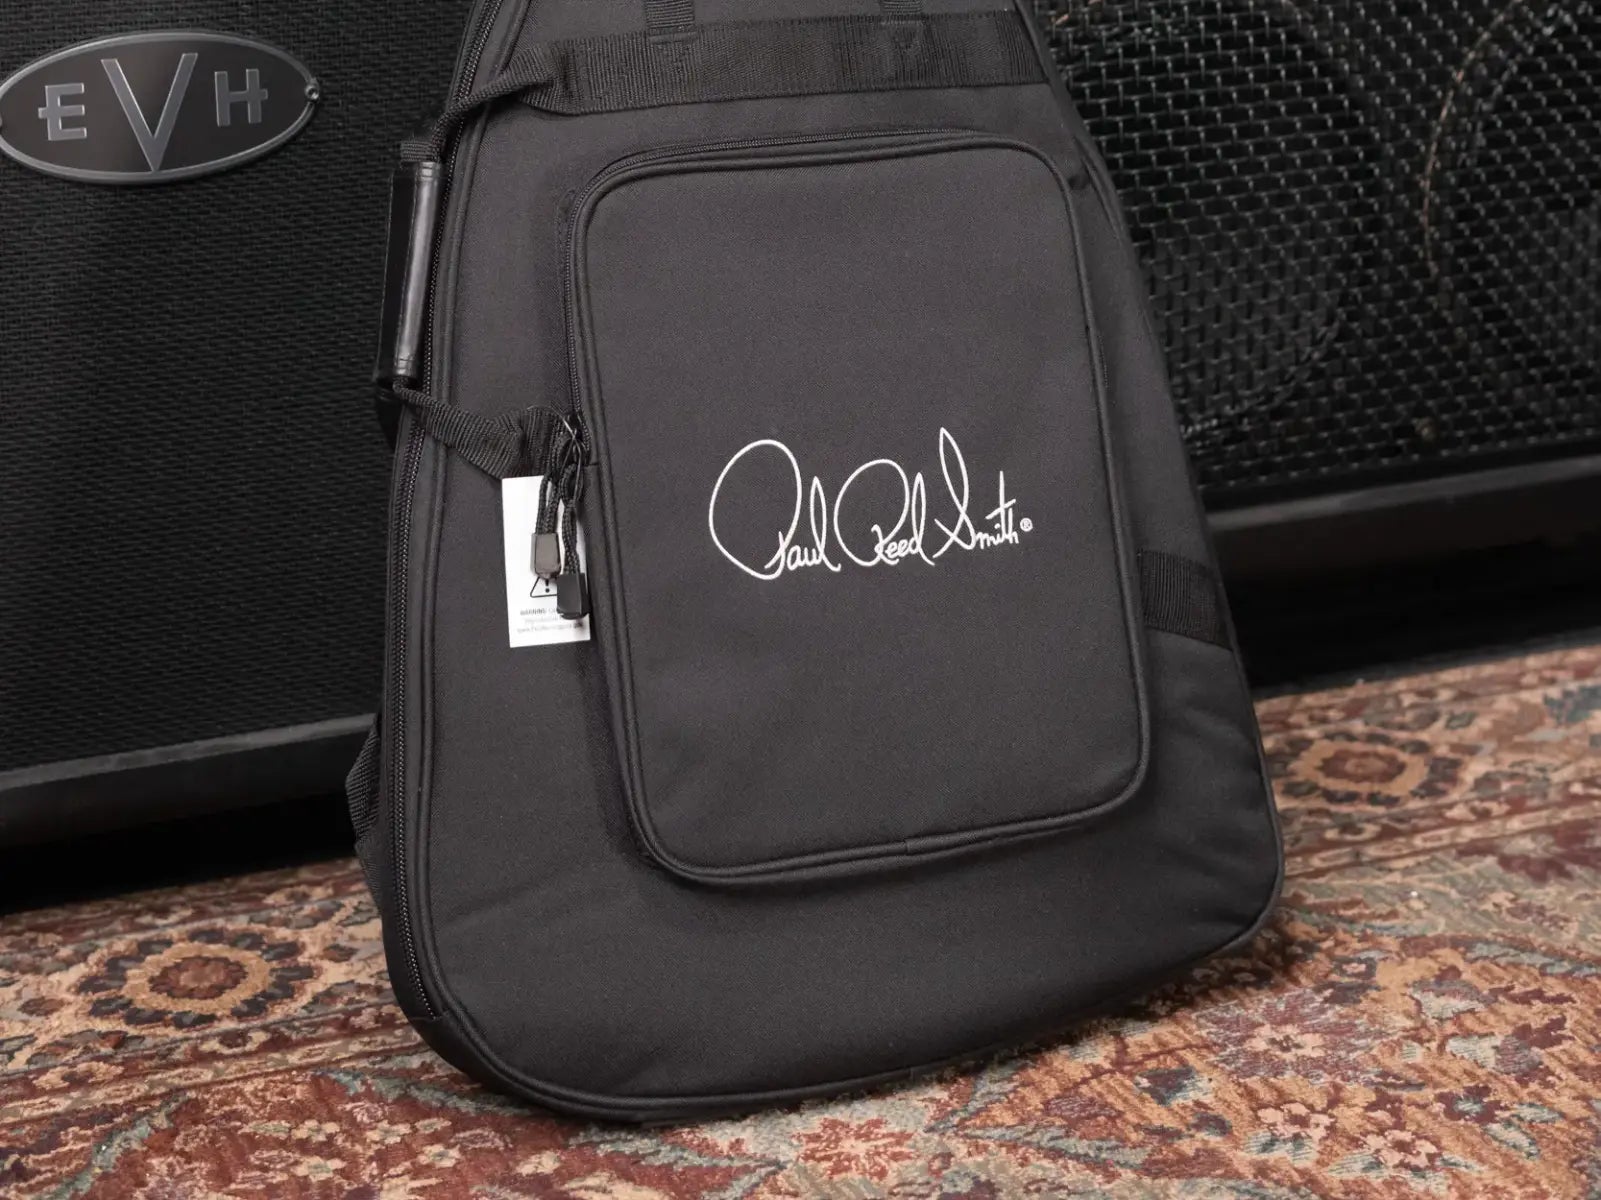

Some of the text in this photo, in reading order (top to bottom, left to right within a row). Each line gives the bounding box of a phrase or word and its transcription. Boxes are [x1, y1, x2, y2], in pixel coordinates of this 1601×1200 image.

[38, 52, 268, 172] EVH
[708, 439, 842, 581] Paul
[833, 458, 936, 567] Reed
